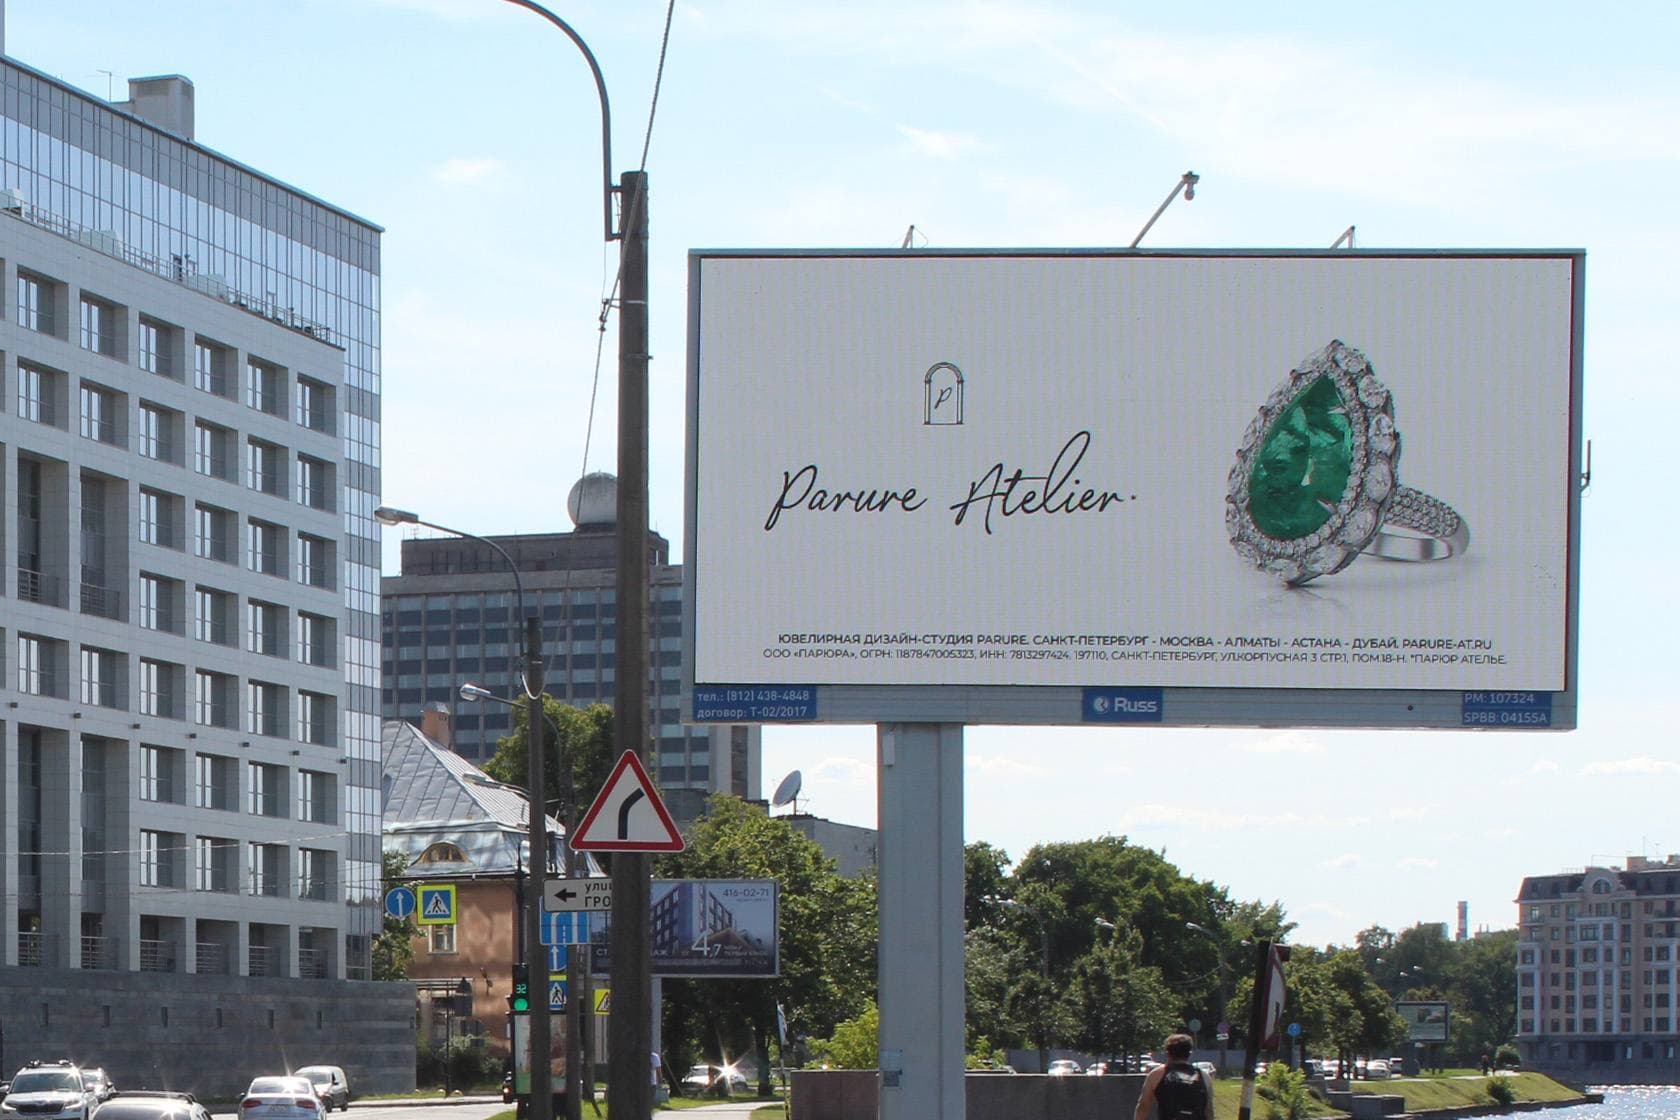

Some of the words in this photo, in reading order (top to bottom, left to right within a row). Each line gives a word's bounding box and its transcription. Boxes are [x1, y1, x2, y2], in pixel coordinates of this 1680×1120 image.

[764, 464, 928, 531] Parure
[778, 633, 861, 645] ЮВЕЛИРНАЯ
[863, 632, 974, 646] ДИЗАЙН-СТУДИЯ
[1032, 634, 1150, 647] САНКТ-ПЕТЕРБУРГ
[1159, 636, 1214, 647] МОСКВА
[1224, 636, 1281, 648] АЛМАТЫ
[1291, 637, 1342, 648] АСТАНА
[1402, 638, 1492, 650] PARURE-AT.RU
[763, 649, 791, 659] ООО
[793, 649, 857, 660] «ПАРЮРА»,
[860, 649, 894, 659] ОГРН:
[979, 650, 1007, 659] ИНН:
[1074, 650, 1109, 662] 197110,
[1111, 650, 1218, 663] САНКТ-ПЕТЕРБУРГ,
[1310, 652, 1318, 662] 3
[697, 693, 724, 702] тел.:
[757, 690, 809, 701] 438-4848
[1489, 692, 1536, 704] 107324
[1113, 696, 1158, 713] Russ
[697, 708, 748, 720] договор:
[749, 706, 808, 718] Т-02/2017
[584, 882, 612, 894] ули
[722, 888, 769, 897] 416-02-71
[584, 895, 612, 908] ГРО
